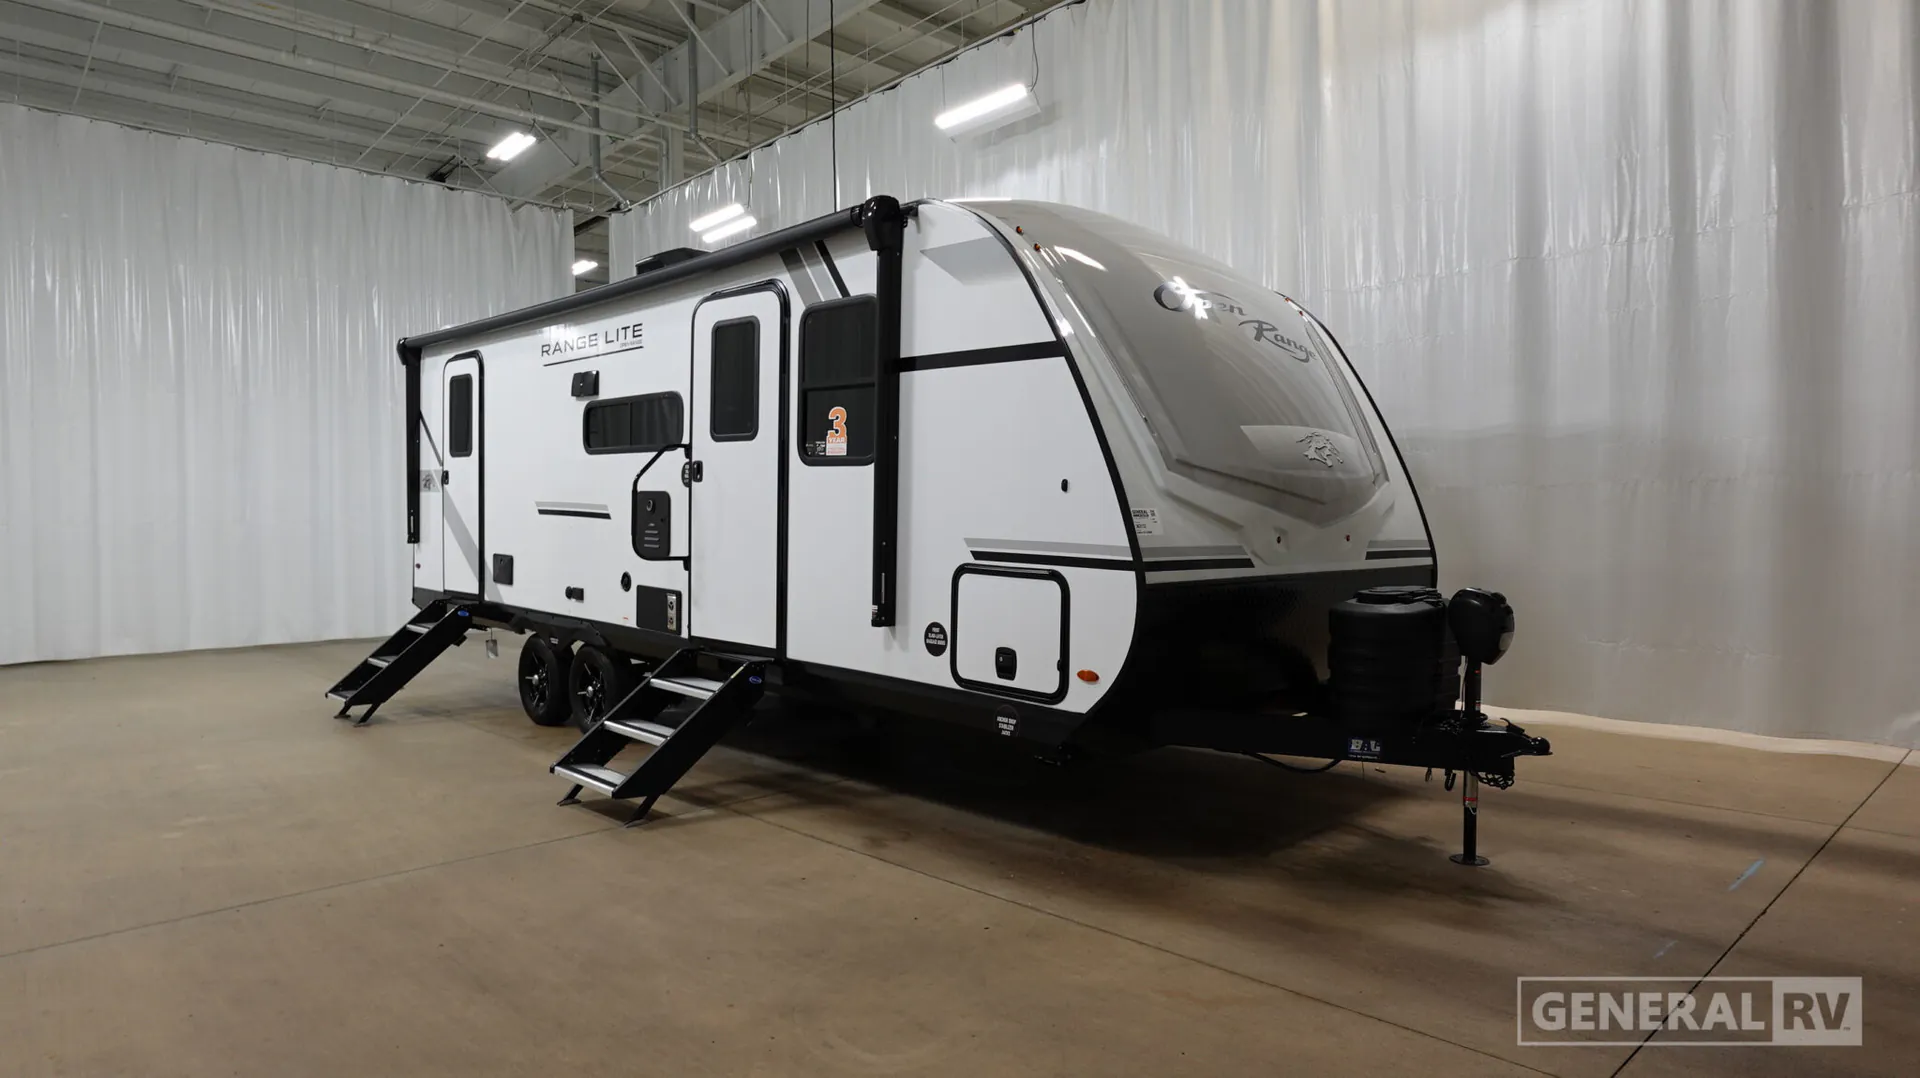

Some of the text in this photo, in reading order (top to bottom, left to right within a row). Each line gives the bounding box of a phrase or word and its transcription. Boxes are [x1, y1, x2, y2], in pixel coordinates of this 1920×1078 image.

[1153, 280, 1247, 320] Open
[541, 323, 643, 357] RANGE LITE
[1238, 319, 1317, 363] Range
[828, 406, 847, 438] 3
